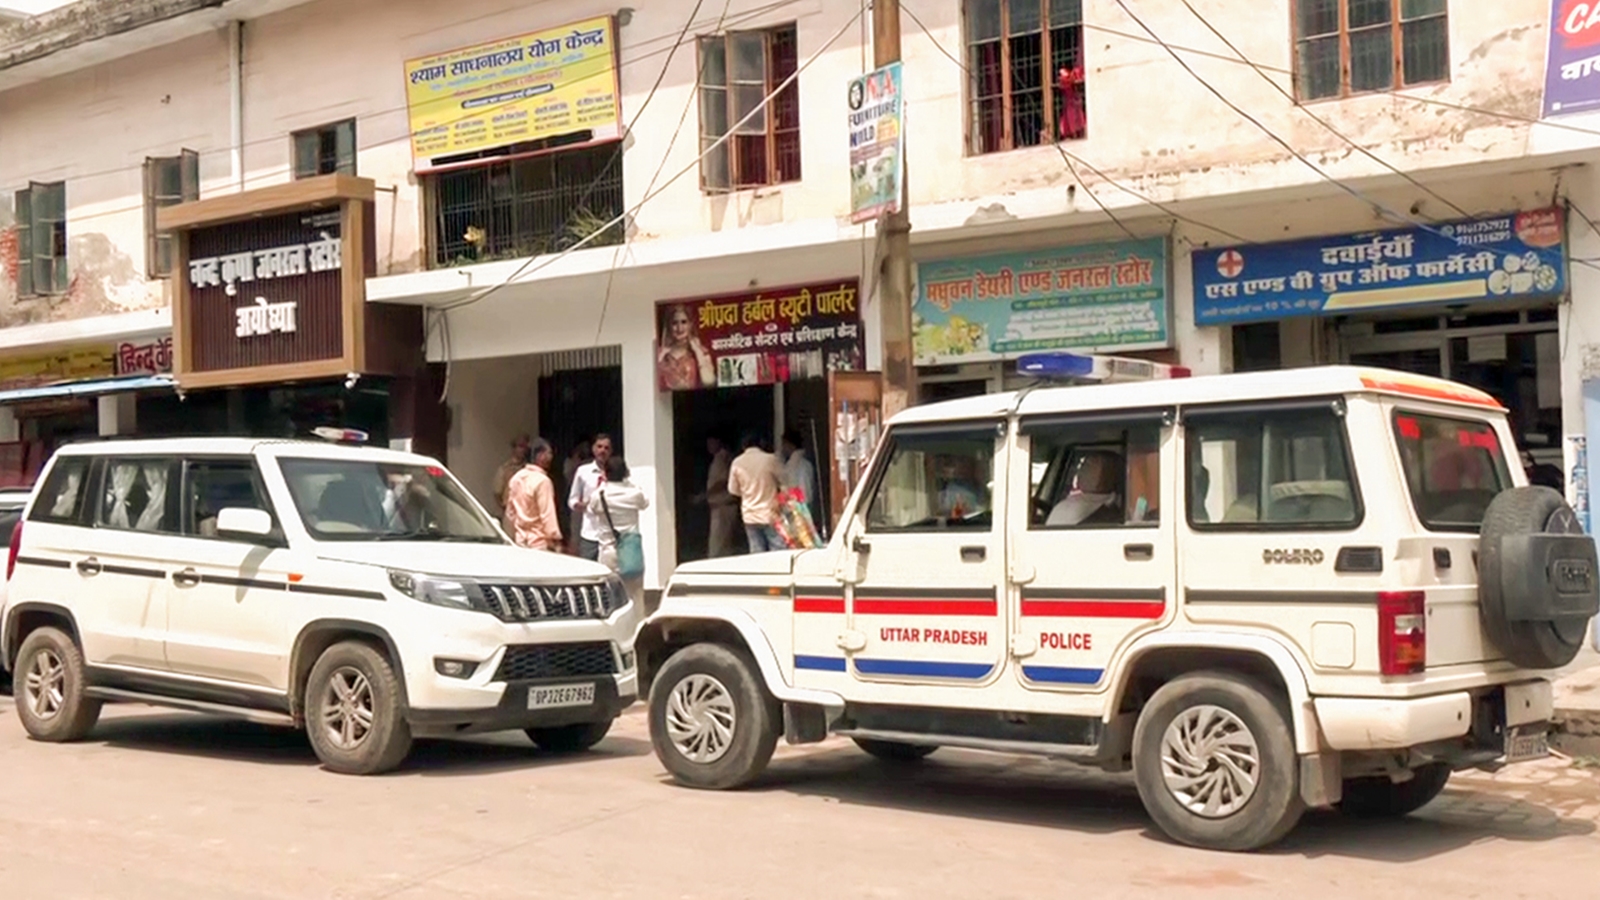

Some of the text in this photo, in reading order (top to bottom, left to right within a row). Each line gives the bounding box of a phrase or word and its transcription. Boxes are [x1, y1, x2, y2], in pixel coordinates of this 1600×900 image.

[410, 64, 446, 85] श्याम
[450, 47, 524, 76] साधनालय
[528, 38, 561, 58] योग
[566, 28, 605, 50] केन्द्र
[253, 244, 307, 279] जनरल
[308, 231, 342, 272] स्टोर
[1018, 270, 1053, 294] एण्ड
[1056, 265, 1112, 290] जनरल
[1115, 255, 1153, 286] स्टोर
[1204, 281, 1239, 299] एस
[1242, 275, 1287, 296] एण्ड
[1318, 270, 1355, 293] ग्रुप
[1357, 262, 1411, 284] ऑफ
[742, 295, 775, 324] हर्बल
[779, 289, 812, 323] ब्यूटी
[816, 284, 857, 314] पार्लर
[1262, 547, 1325, 565] BOLERO
[880, 627, 988, 646] UTTAR PRADESH
[1040, 632, 1093, 651] POLICE
